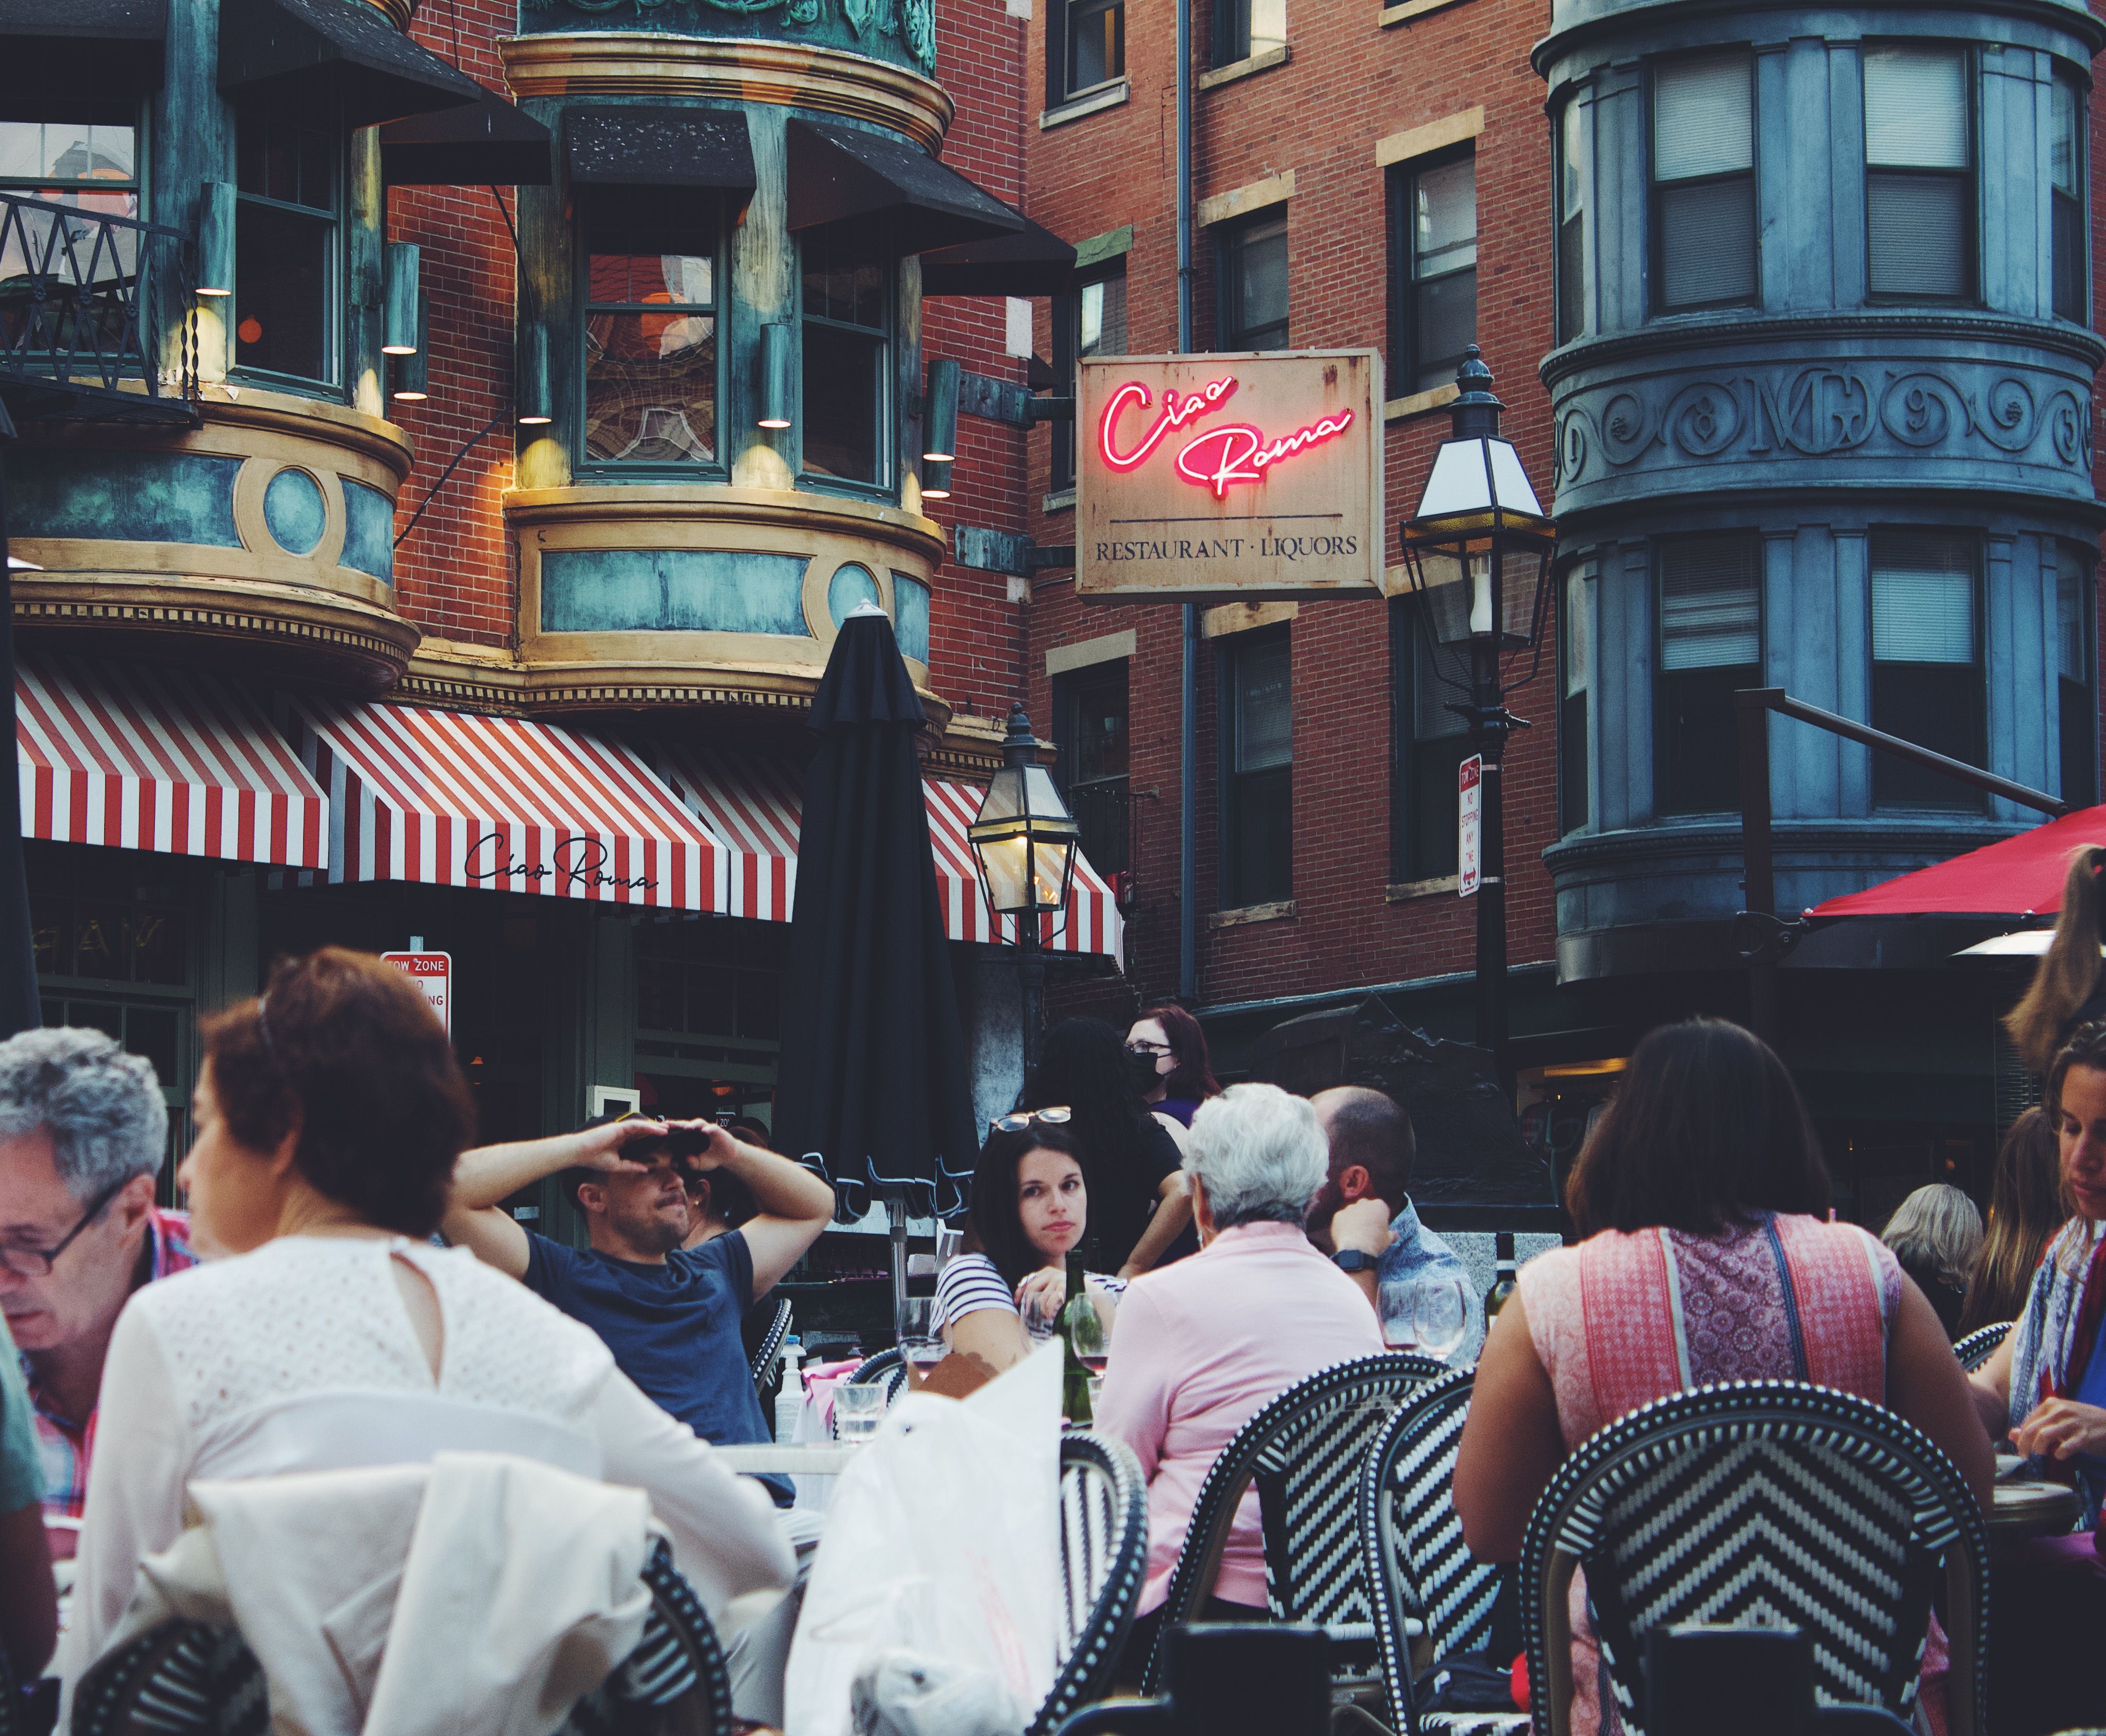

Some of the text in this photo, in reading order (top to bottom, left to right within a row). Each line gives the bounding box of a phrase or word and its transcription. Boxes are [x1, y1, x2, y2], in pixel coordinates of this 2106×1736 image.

[1102, 376, 1234, 466] Ciao
[1178, 412, 1352, 496] Roma
[1096, 536, 1358, 561] RESTAURANT LIQUORS
[1469, 765, 1479, 781] ZONE
[1467, 792, 1473, 805] NO
[464, 832, 660, 894] Ciao Roma
[414, 960, 445, 972] ZONE
